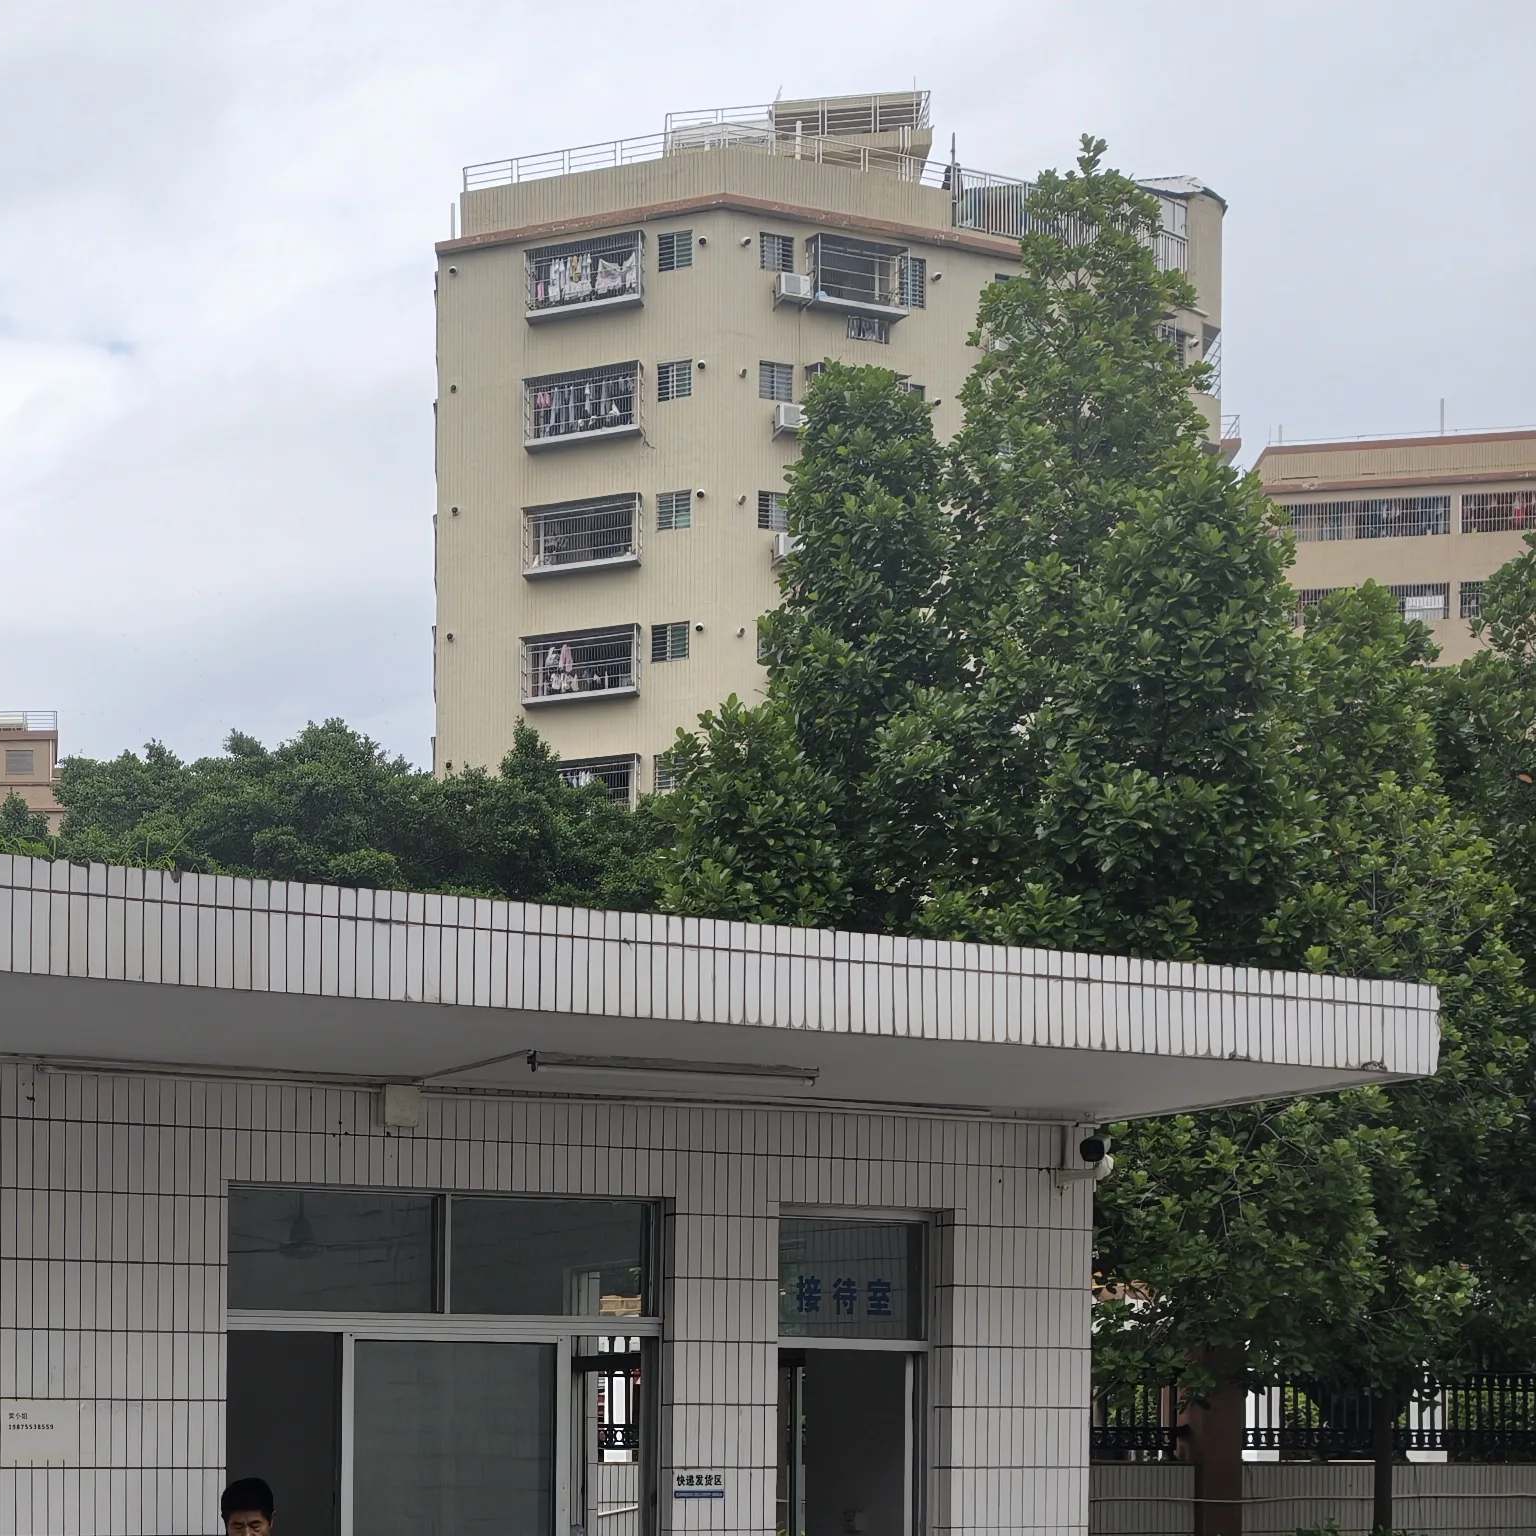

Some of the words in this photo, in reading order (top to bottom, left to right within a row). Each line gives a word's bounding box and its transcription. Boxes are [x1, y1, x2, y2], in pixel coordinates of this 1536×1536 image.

[796, 1275, 892, 1316] 接待室
[676, 1474, 723, 1487] 快递发货区
